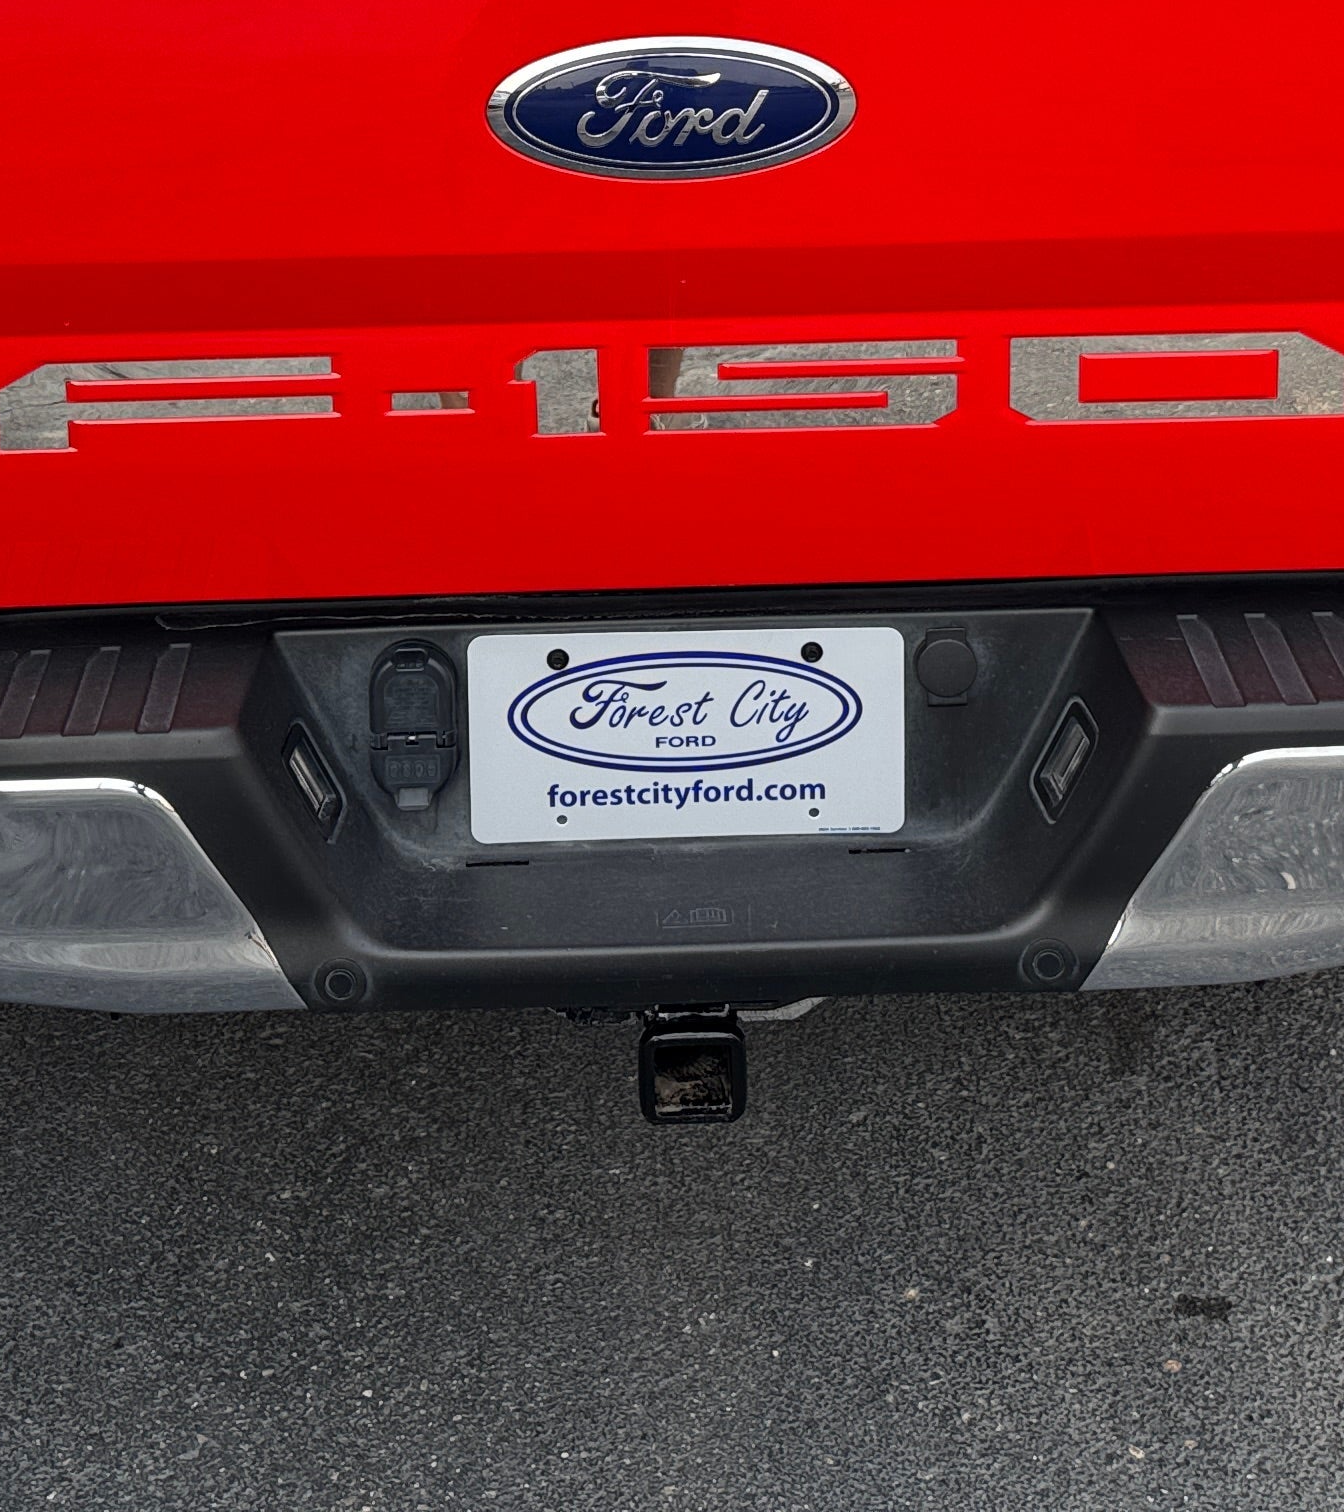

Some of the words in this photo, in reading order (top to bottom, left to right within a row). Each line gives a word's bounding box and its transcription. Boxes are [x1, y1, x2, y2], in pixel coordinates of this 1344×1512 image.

[576, 69, 769, 147] Ford
[569, 679, 714, 730] Forest
[729, 679, 810, 743] City
[655, 735, 717, 748] FORD
[547, 778, 826, 809] forestcityford.com
